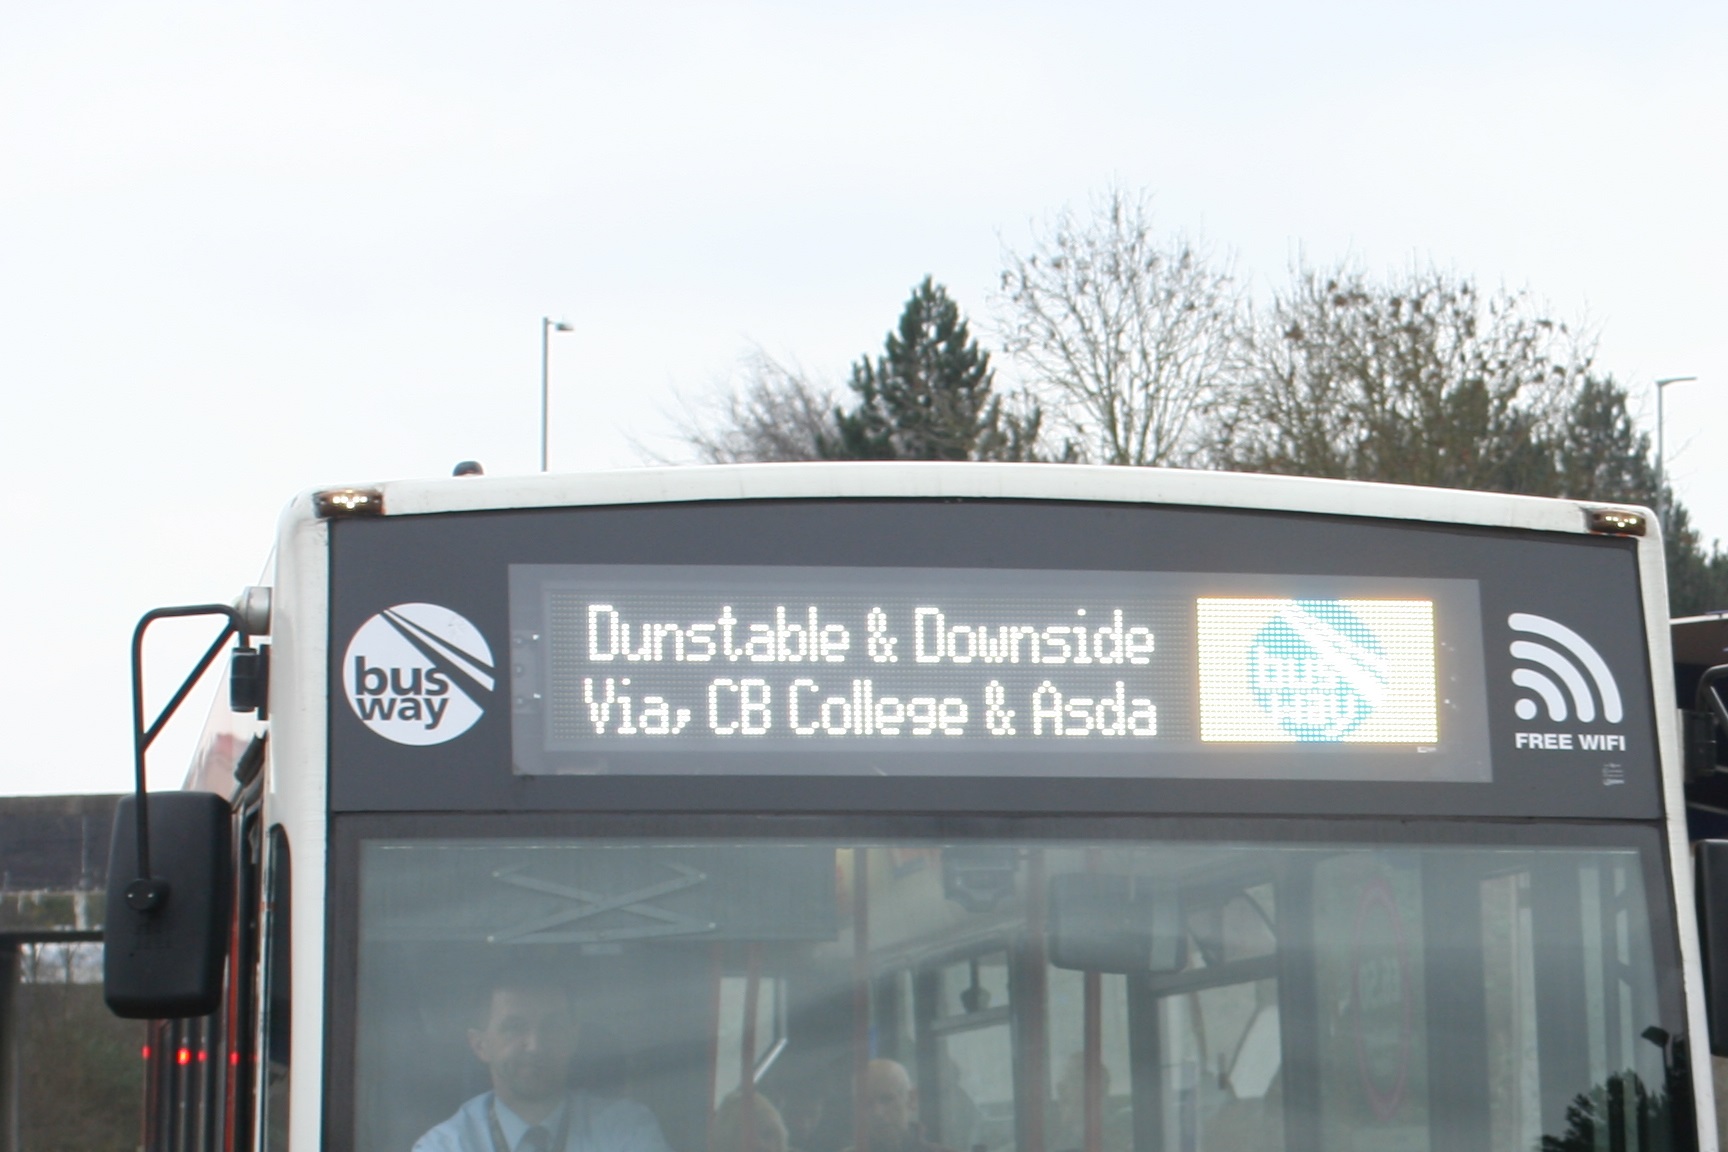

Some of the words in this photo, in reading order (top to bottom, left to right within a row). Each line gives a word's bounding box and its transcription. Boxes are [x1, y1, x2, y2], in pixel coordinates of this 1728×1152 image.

[586, 604, 851, 663] Dunstable
[866, 606, 899, 664] &
[914, 606, 1156, 666] Downside
[354, 655, 450, 697] bus
[354, 696, 450, 731] way
[583, 677, 692, 736] Via,
[708, 678, 771, 736] CB
[788, 678, 969, 737] College
[984, 679, 1017, 737] &
[1032, 679, 1158, 738] Asda
[1514, 732, 1574, 750] FREE
[1578, 733, 1627, 751] WIFI
